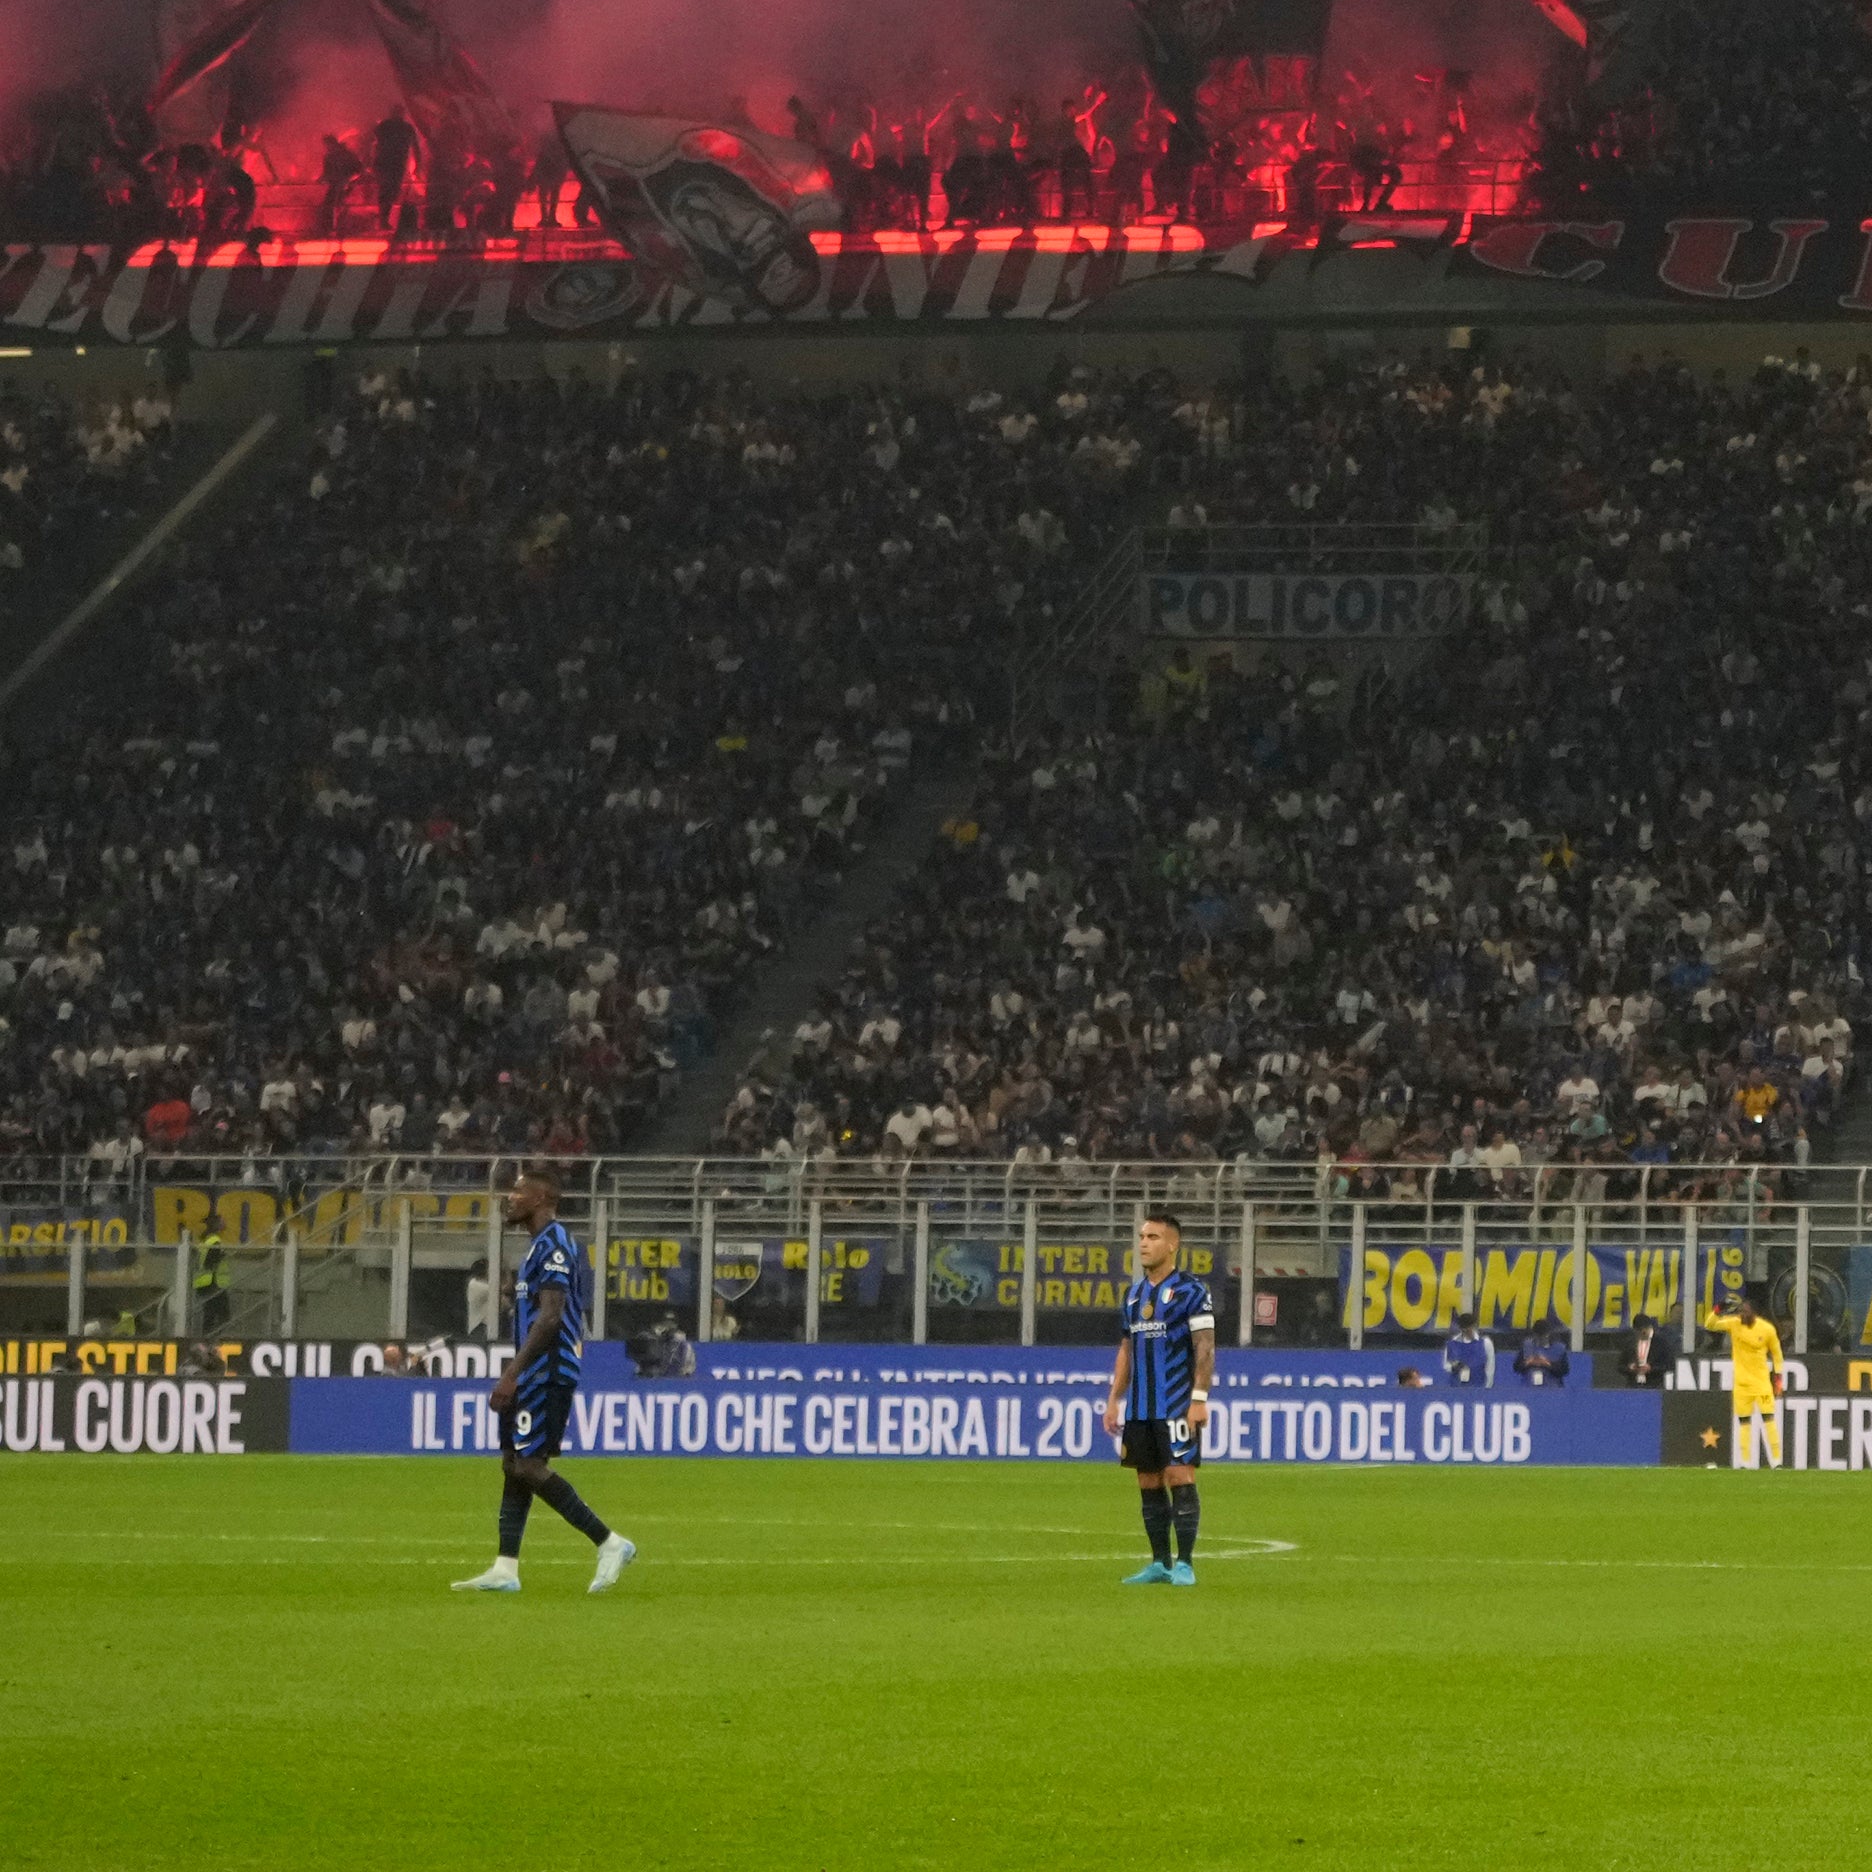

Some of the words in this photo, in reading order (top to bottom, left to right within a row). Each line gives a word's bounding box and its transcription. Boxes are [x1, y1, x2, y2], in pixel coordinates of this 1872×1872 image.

[1342, 1248, 1601, 1331] BORMIO
[74, 1379, 247, 1455] CUORE
[411, 1391, 446, 1450] IL
[452, 1391, 501, 1451] FIL
[561, 1392, 709, 1454] VENTO
[714, 1393, 798, 1455] CHE
[804, 1394, 989, 1457] CELEBRA
[996, 1398, 1031, 1457] IL
[1340, 1401, 1416, 1461] DEL
[1423, 1400, 1533, 1463] CLUB
[516, 1409, 532, 1436] 9
[1166, 1417, 1191, 1444] 10
